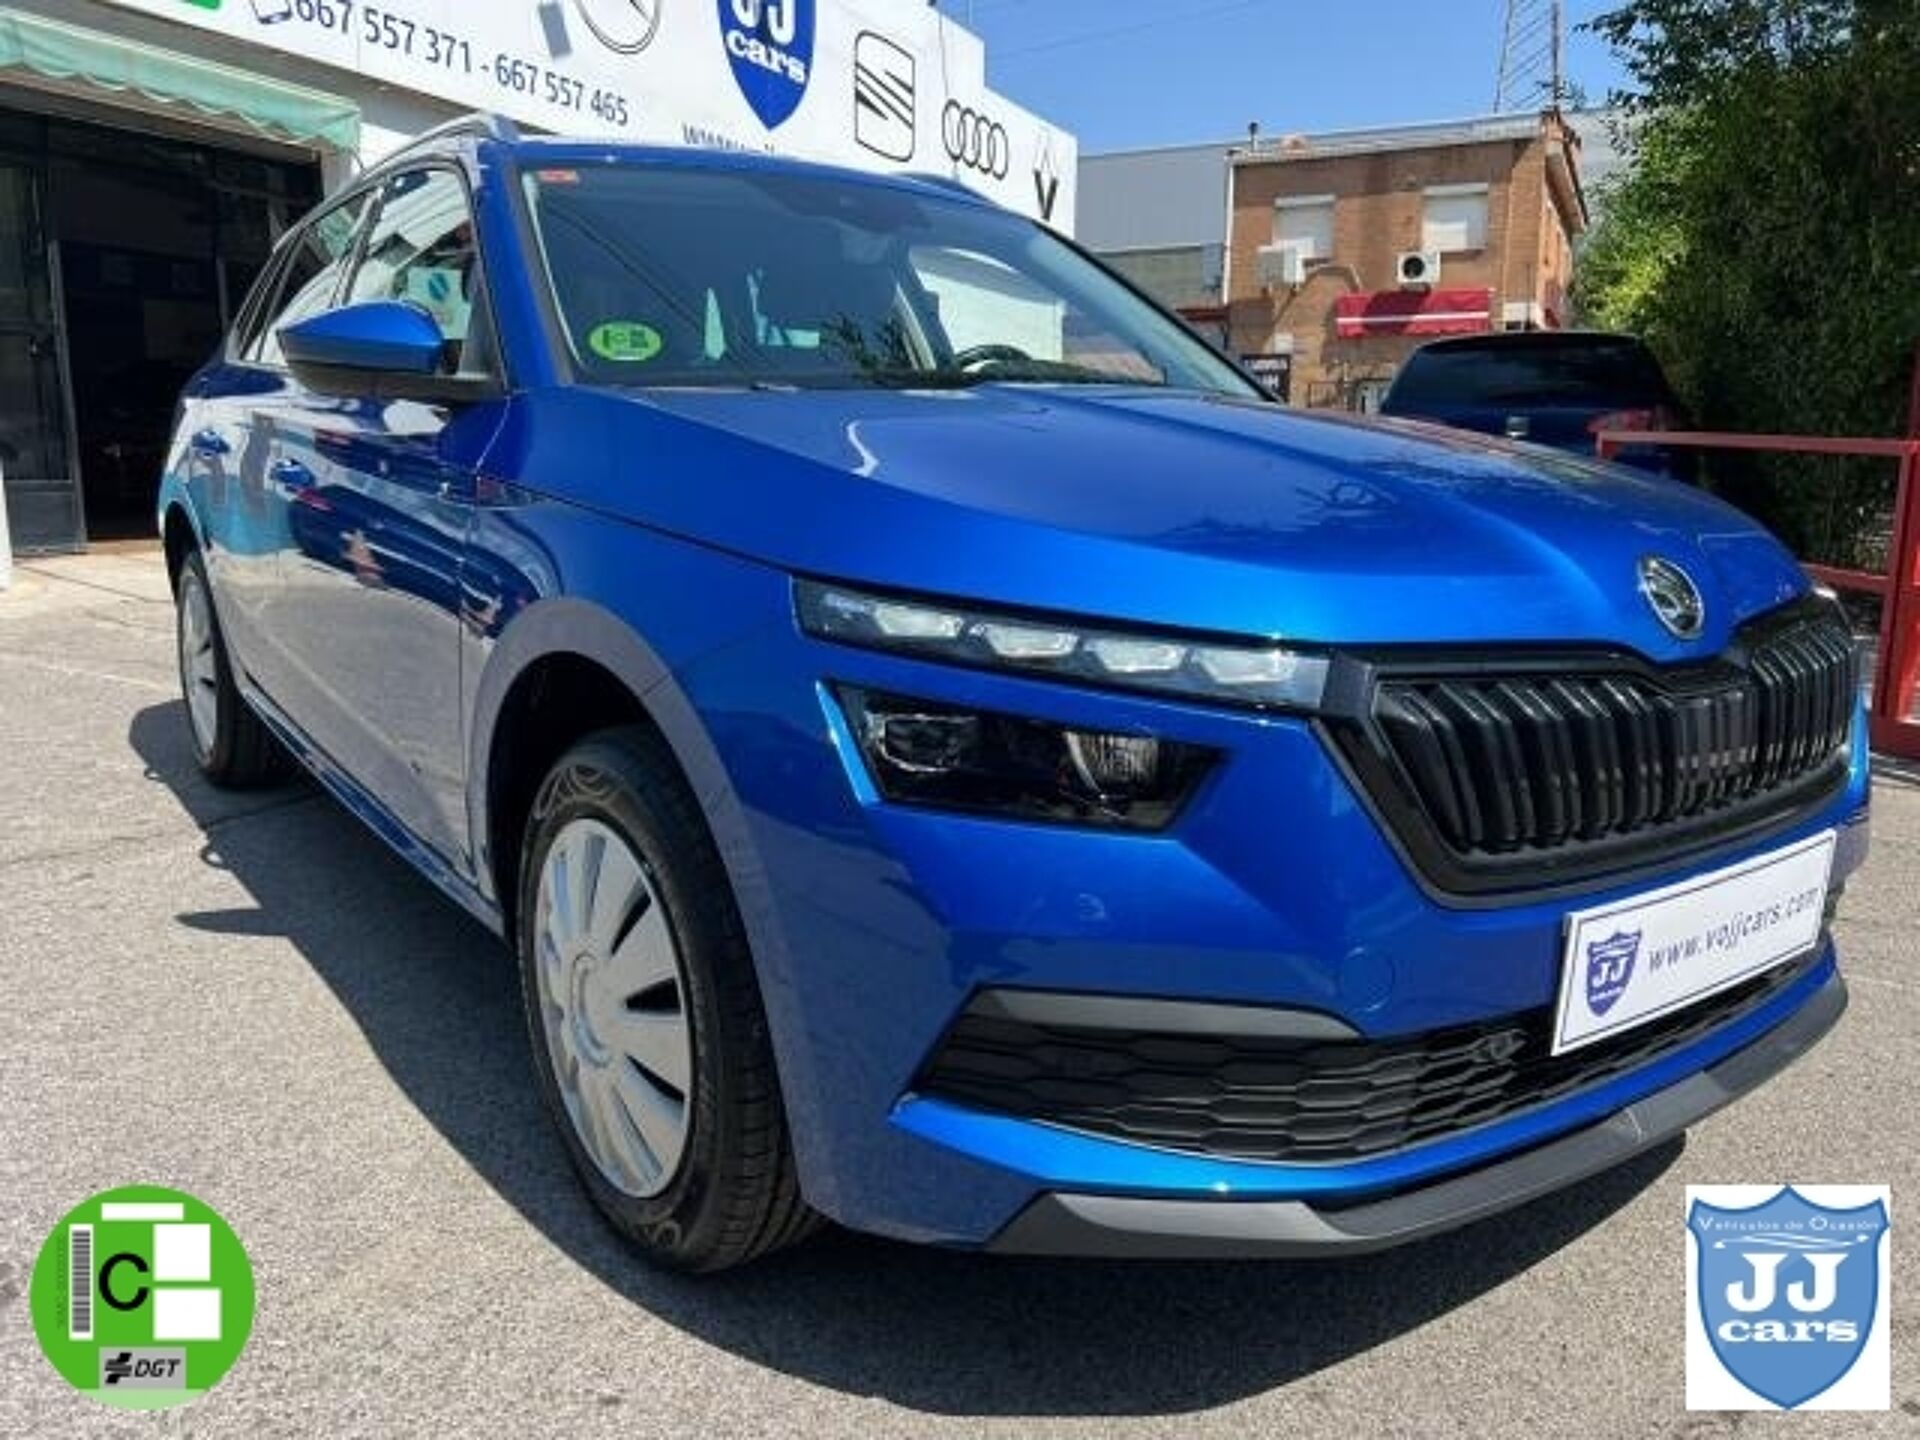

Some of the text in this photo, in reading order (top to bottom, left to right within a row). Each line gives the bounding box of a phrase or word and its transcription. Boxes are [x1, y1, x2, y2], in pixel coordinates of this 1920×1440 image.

[364, 8, 415, 54] 557
[425, 28, 472, 74] 371
[496, 54, 537, 96] 667
[545, 72, 585, 111] 557
[590, 93, 629, 127] 465
[726, 29, 806, 84] cars
